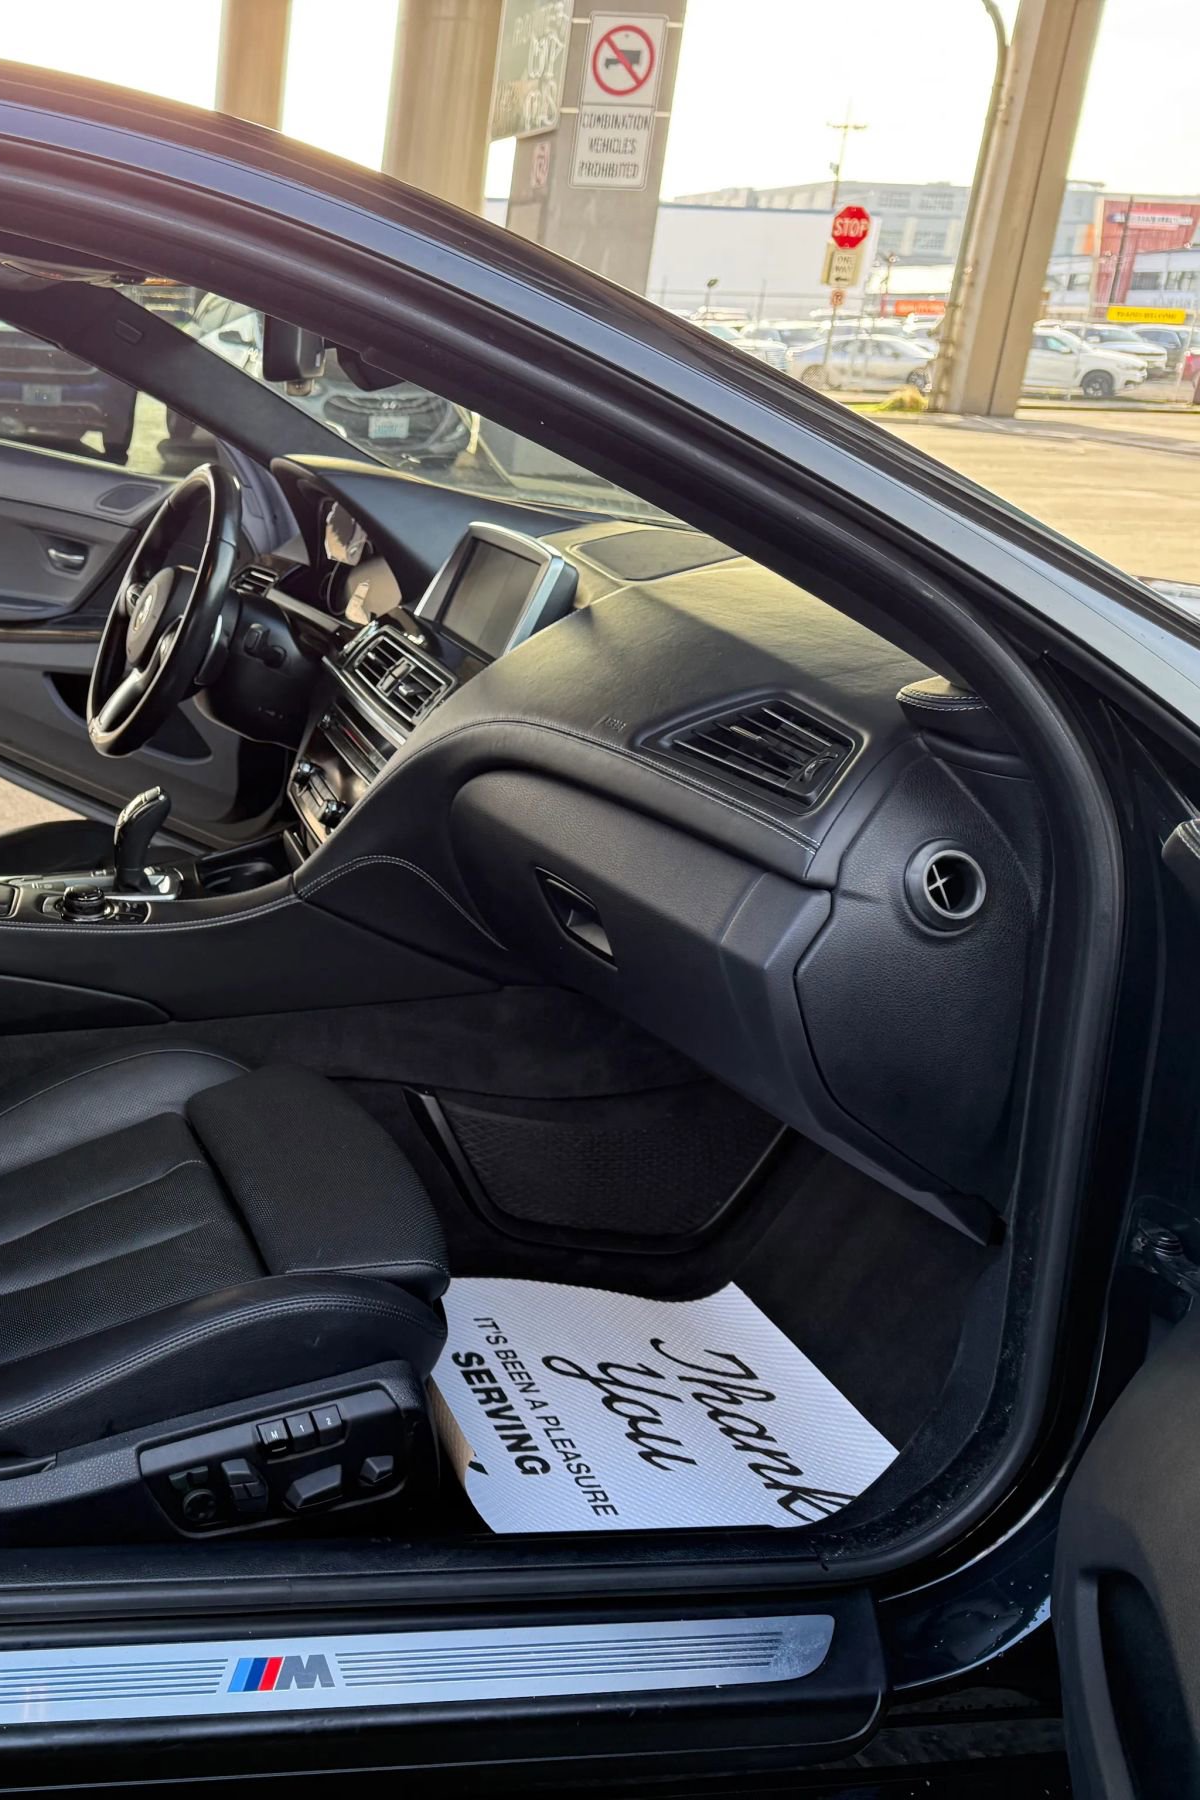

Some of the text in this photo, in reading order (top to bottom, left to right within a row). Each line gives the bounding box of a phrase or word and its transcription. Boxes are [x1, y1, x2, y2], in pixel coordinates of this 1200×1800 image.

[581, 112, 650, 131] COMBINATION
[588, 136, 637, 155] VEHICLES
[577, 160, 640, 179] PROHIBITED
[834, 217, 869, 238] STOP
[834, 265, 854, 273] WAY
[836, 255, 854, 264] ONE
[451, 1351, 552, 1476] SERVING
[473, 1317, 620, 1517] IT'S BEEN A PLEASURE
[541, 1353, 698, 1472] You
[270, 1430, 279, 1440] M
[325, 1417, 332, 1425] 2
[650, 1337, 856, 1523] Thank
